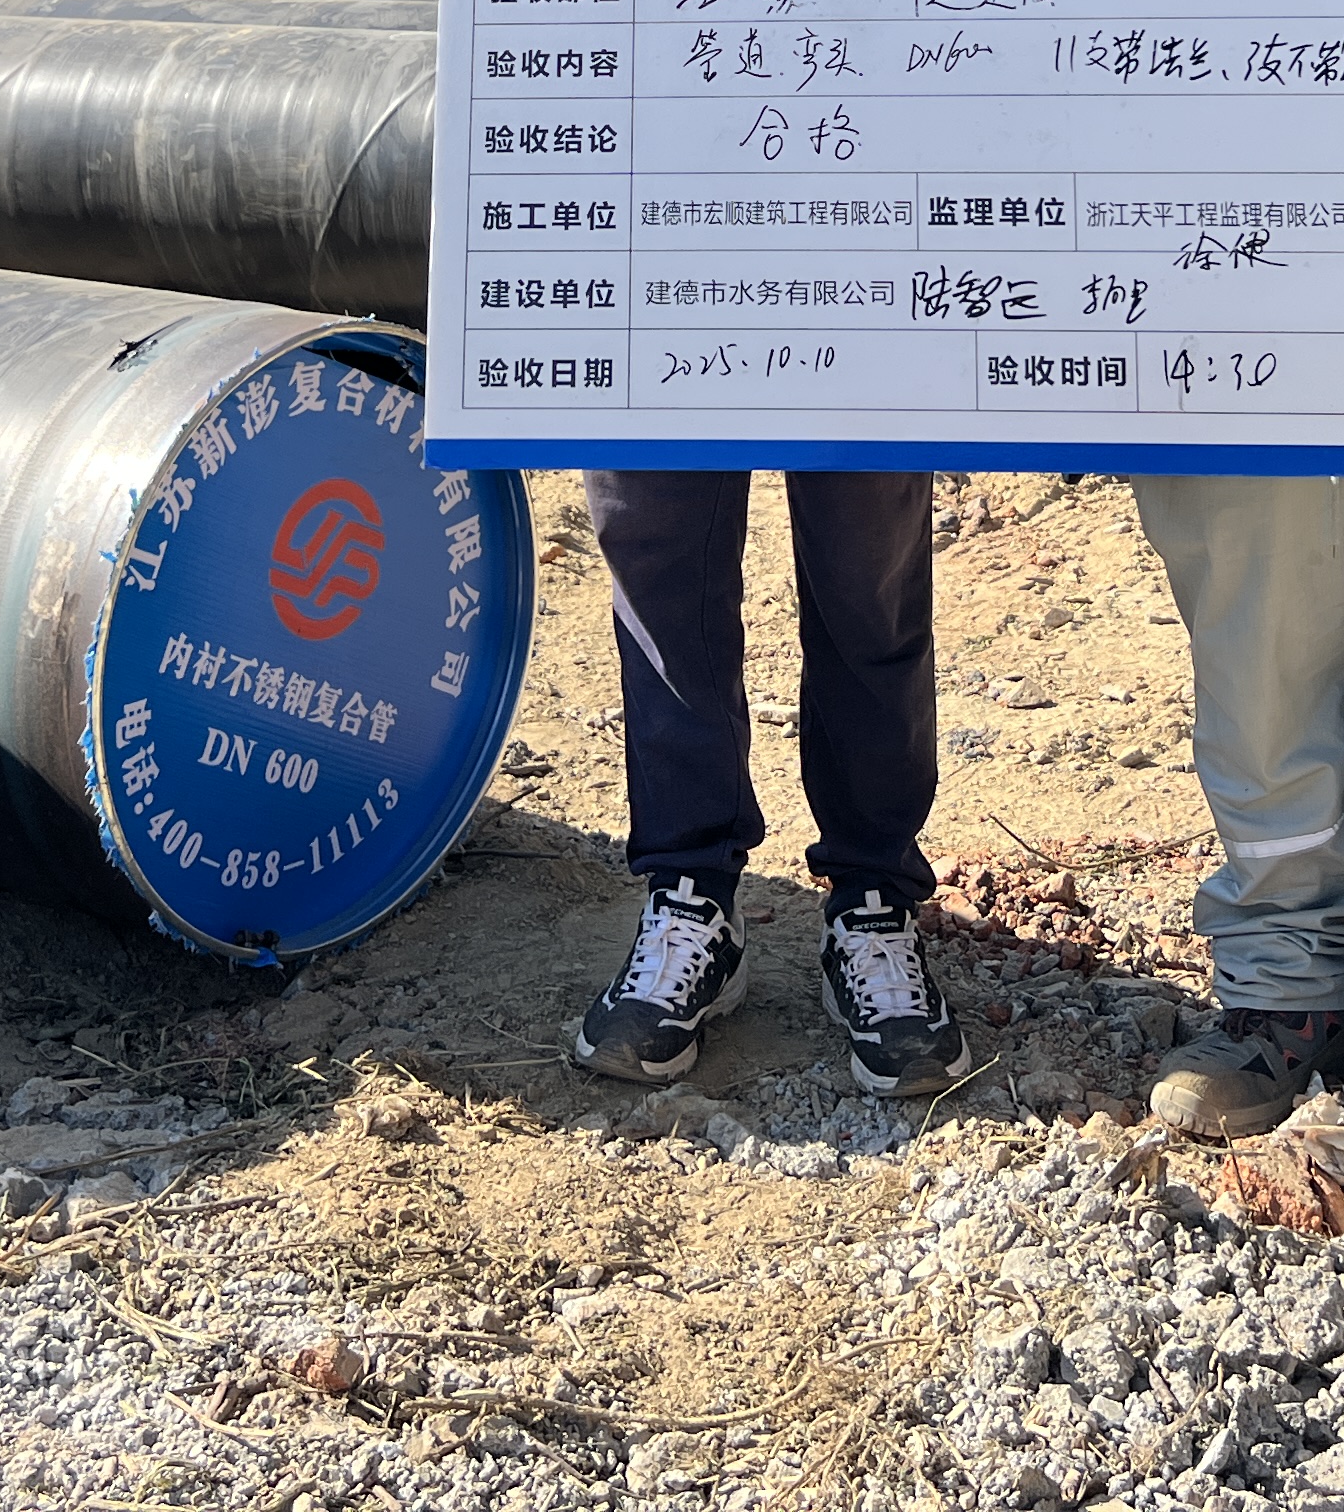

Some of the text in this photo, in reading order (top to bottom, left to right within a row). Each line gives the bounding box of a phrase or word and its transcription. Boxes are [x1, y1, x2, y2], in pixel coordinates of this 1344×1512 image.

[486, 49, 619, 78] 验收内容
[484, 124, 618, 154] 验收结论
[740, 104, 860, 161] 合格
[482, 201, 617, 231] 施工单位
[640, 200, 913, 228] 建德市宏顺建筑工程有限公司
[928, 197, 1067, 227] 监理单位
[480, 278, 616, 309] 建设单位
[645, 279, 896, 307] 建德市水务有限公司
[478, 358, 614, 388] 验收日期
[987, 355, 1128, 387] 验收时间
[158, 632, 399, 745] 内衬不锈钢复合管
[198, 727, 319, 792] DN 600
